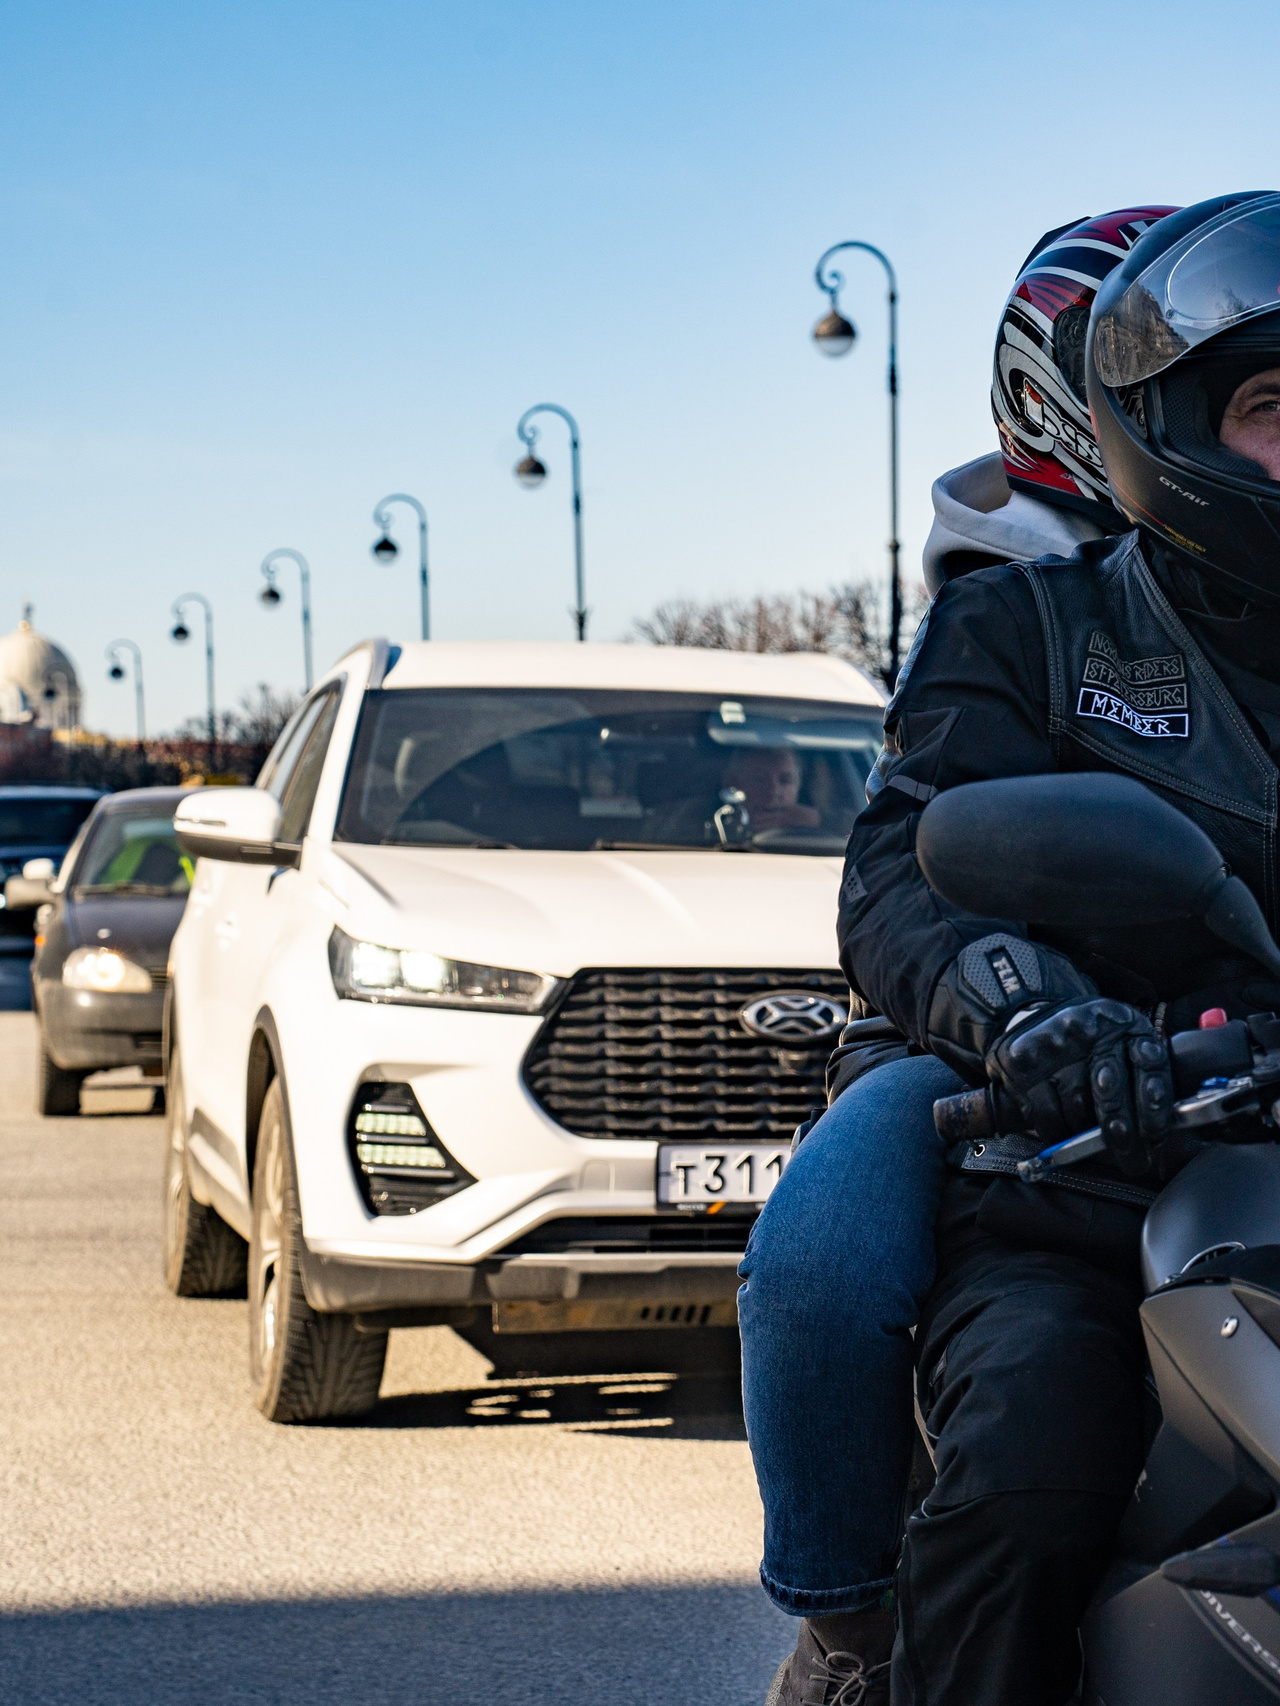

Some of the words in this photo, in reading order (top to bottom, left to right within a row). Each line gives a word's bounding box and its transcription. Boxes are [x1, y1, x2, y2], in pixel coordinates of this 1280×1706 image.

[1133, 658, 1180, 681] RIDERS
[1090, 693, 1171, 734] MEMBER
[992, 955, 1020, 995] FLM
